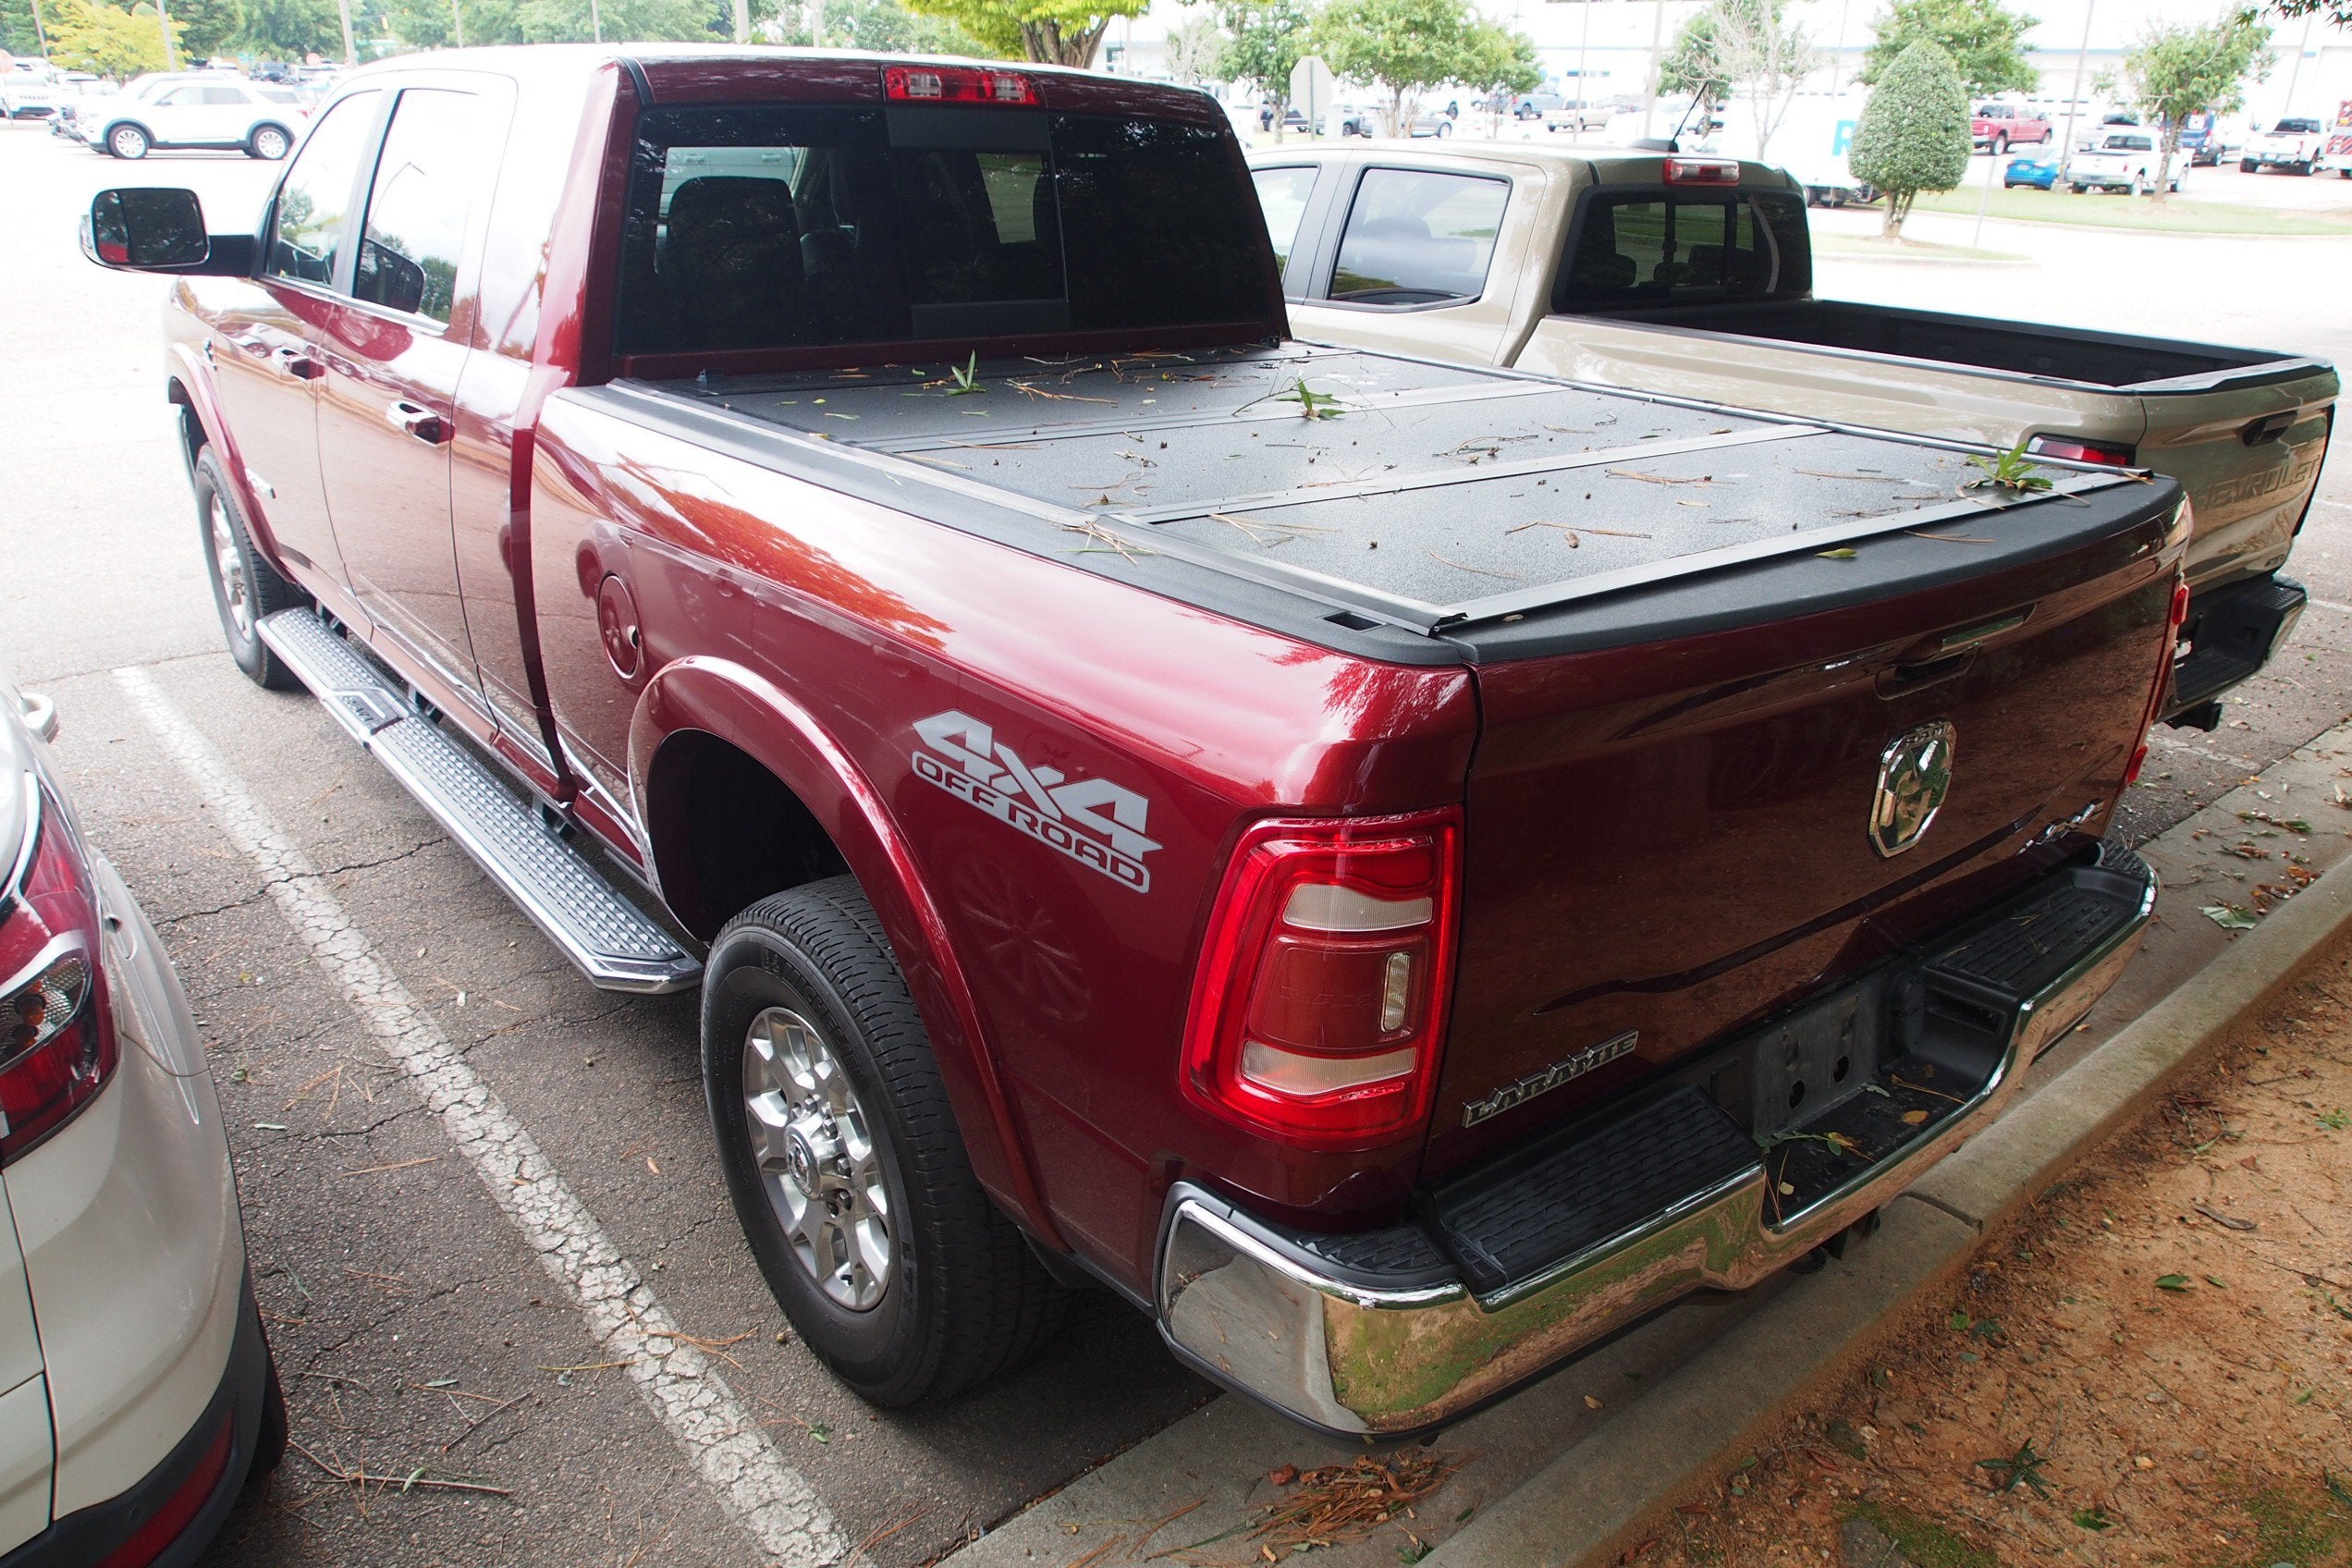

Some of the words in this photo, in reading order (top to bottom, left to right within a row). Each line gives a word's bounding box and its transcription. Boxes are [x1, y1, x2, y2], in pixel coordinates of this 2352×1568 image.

[916, 753, 1000, 808] OFF
[1008, 804, 1145, 887] ROAD
[1460, 1029, 1639, 1128] LARAMIE
